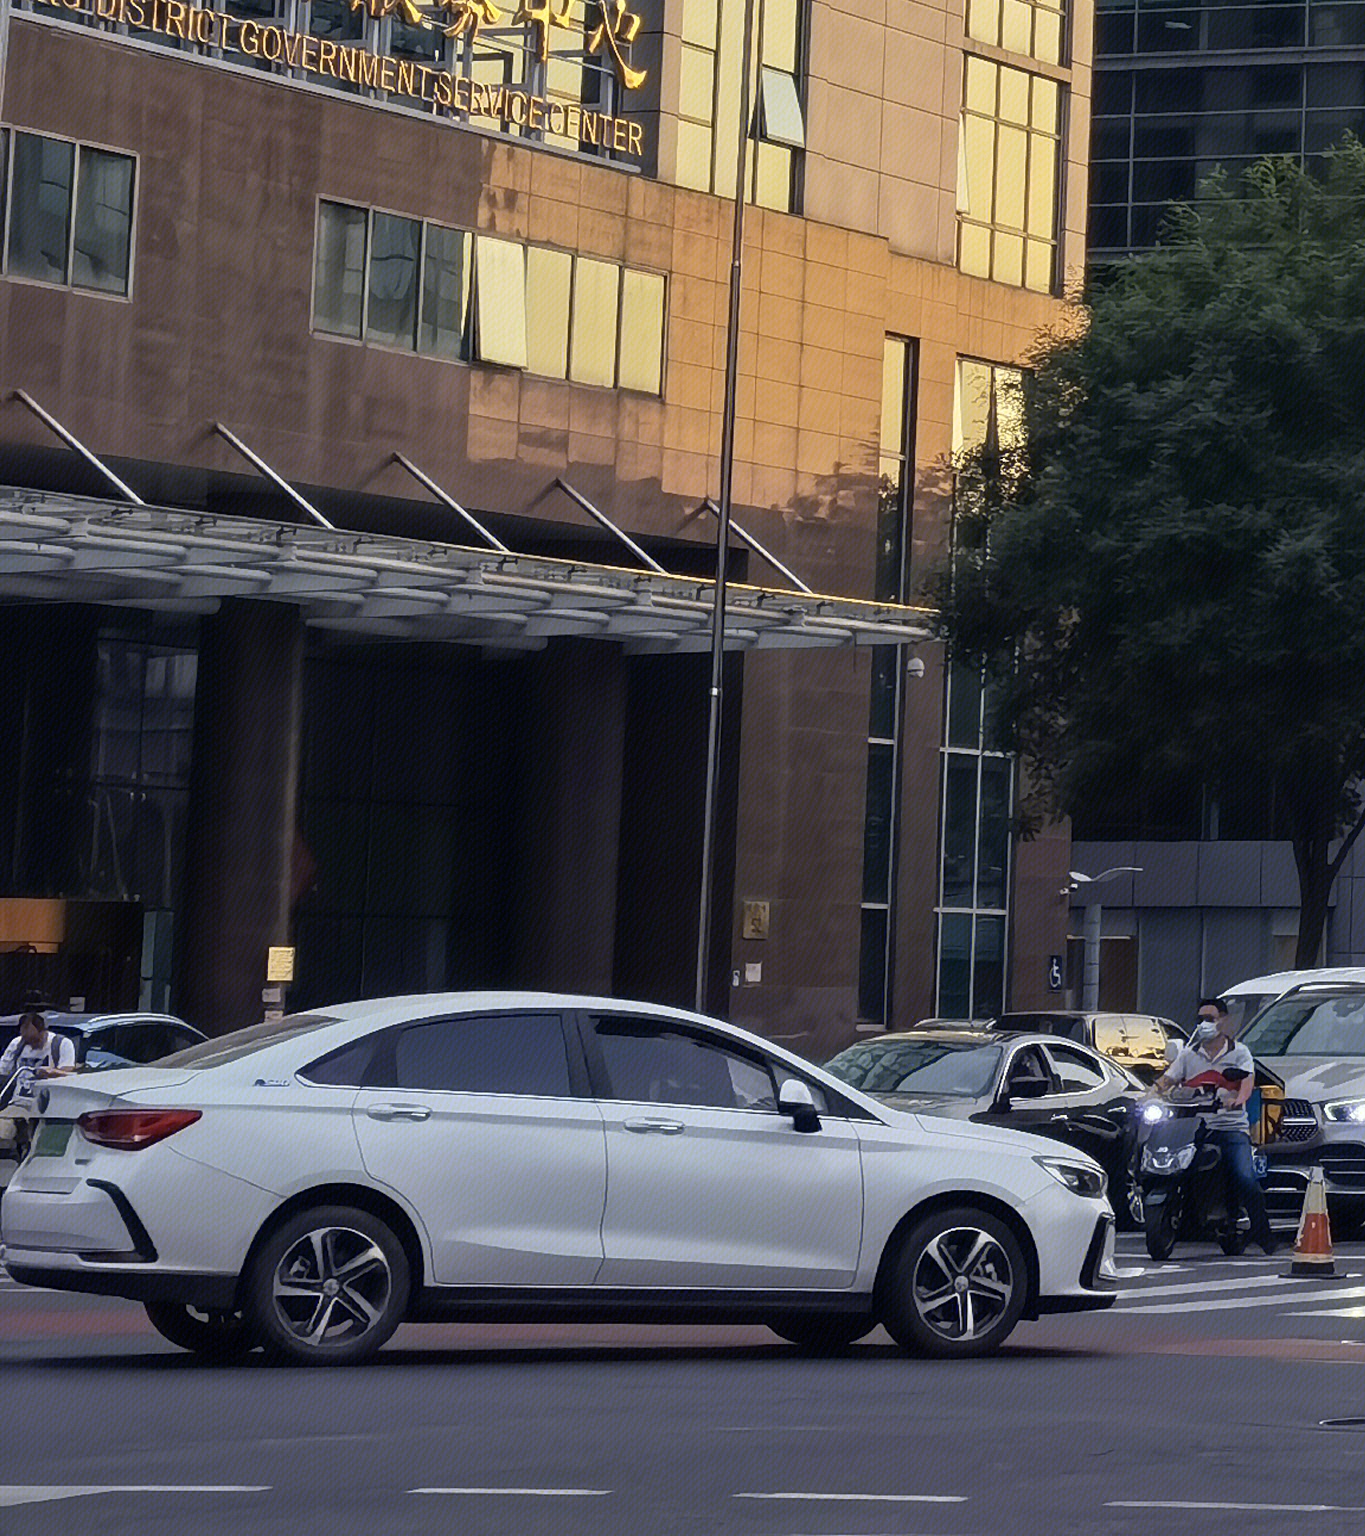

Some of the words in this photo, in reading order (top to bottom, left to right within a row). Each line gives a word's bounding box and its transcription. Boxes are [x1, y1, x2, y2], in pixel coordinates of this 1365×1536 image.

[239, 20, 442, 100] GOVERNMENT
[436, 71, 547, 130] SERVICE
[547, 101, 643, 157] CENTER
